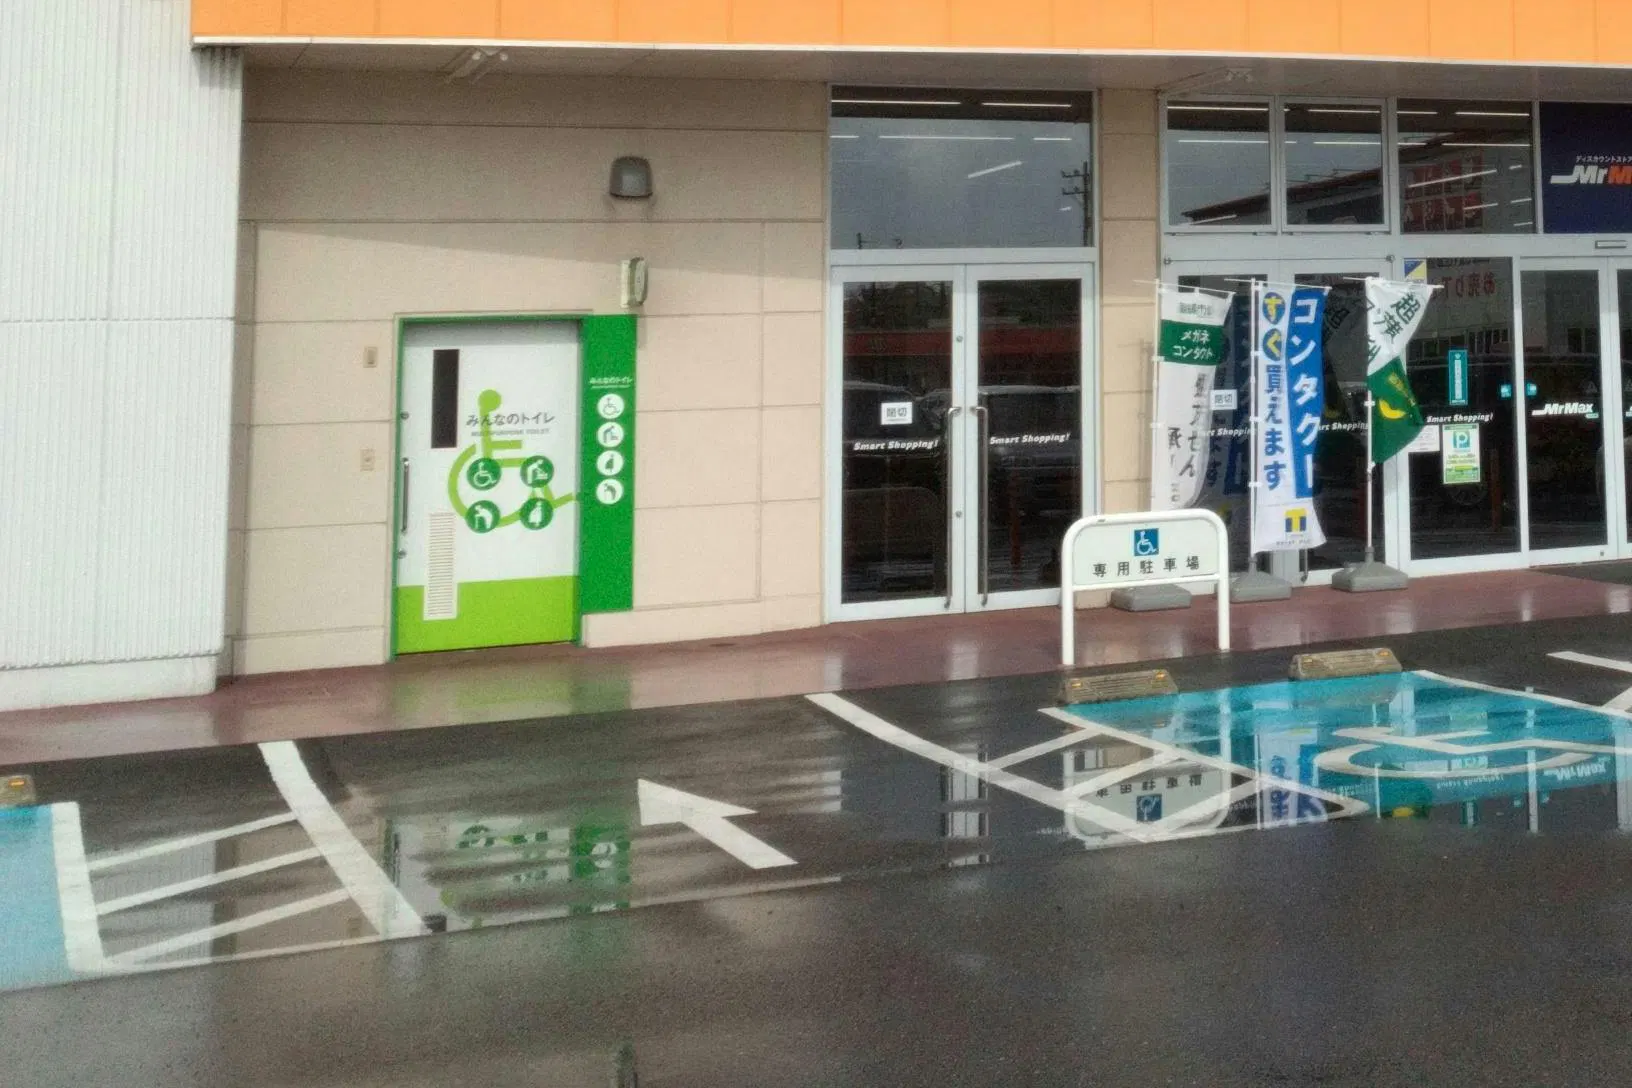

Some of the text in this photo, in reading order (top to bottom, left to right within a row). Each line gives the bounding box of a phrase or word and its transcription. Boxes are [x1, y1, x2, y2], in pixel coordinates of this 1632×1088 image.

[1180, 329, 1211, 345] メガネ
[1172, 344, 1214, 360] コンタクト
[1532, 401, 1593, 415] MrMax
[465, 411, 556, 428] みんなのトイレ
[1427, 415, 1451, 423] Smart
[854, 441, 885, 451] Smart
[990, 435, 1019, 445] Smart
[1092, 555, 1200, 578] 専用駐車場
